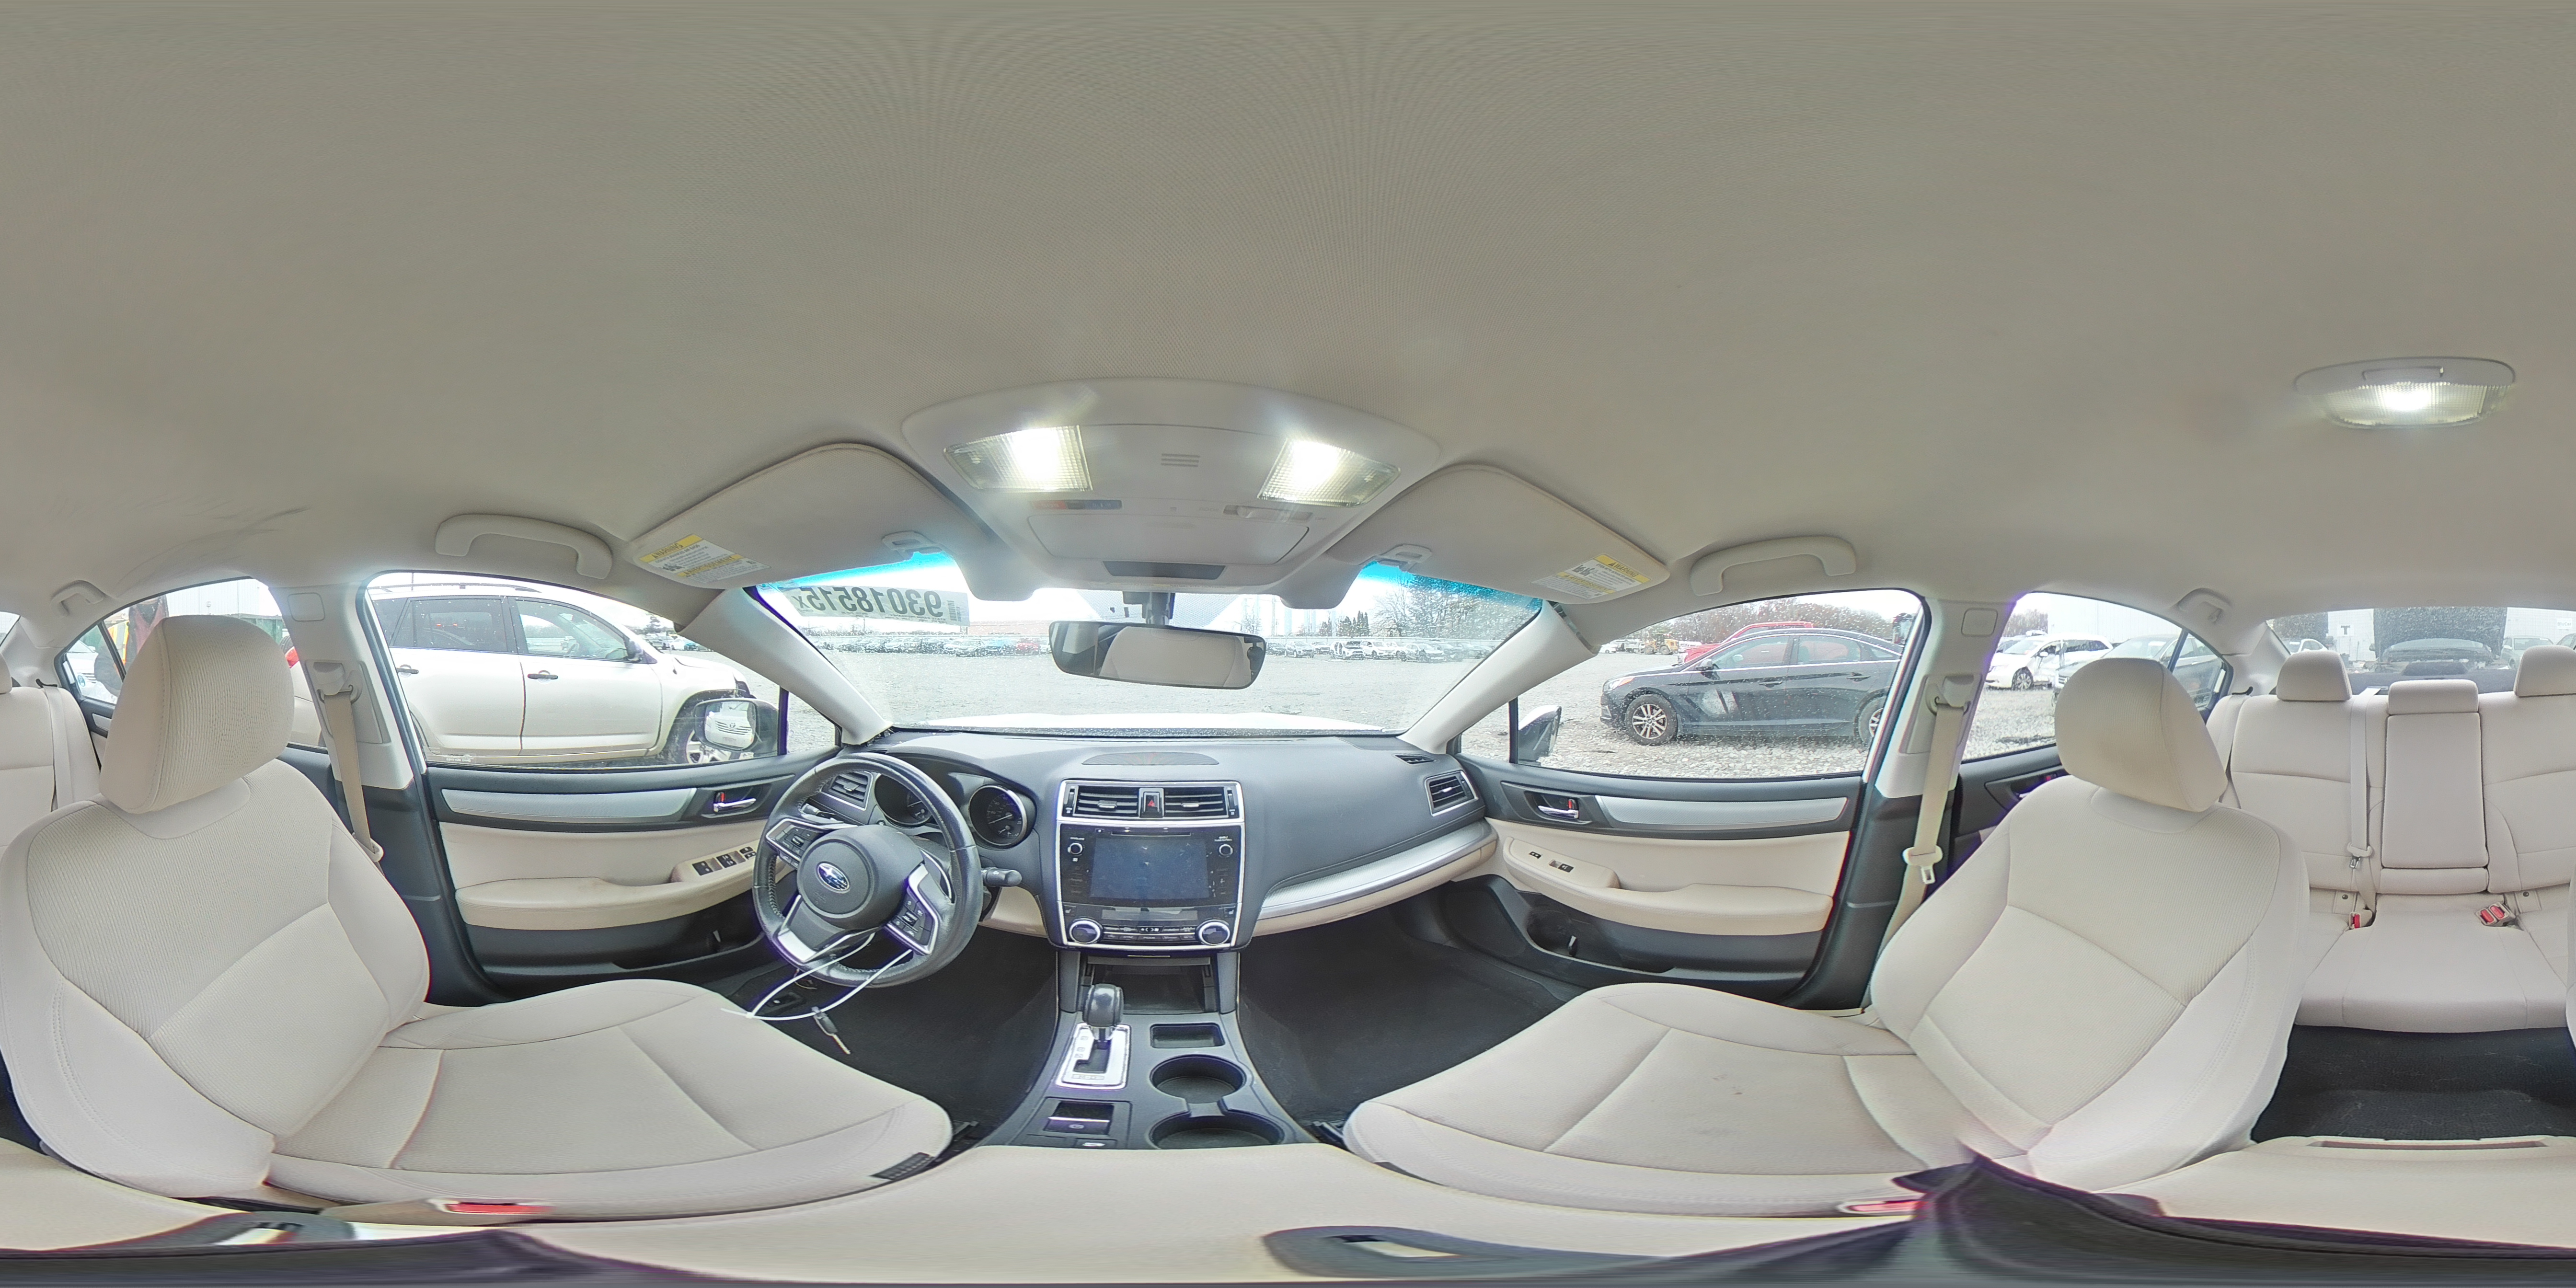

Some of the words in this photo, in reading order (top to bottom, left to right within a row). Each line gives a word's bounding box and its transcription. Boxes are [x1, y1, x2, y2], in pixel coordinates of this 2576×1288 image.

[655, 543, 683, 556] WARNING
[1614, 564, 1639, 577] WARNING
[2340, 625, 2351, 635] T
